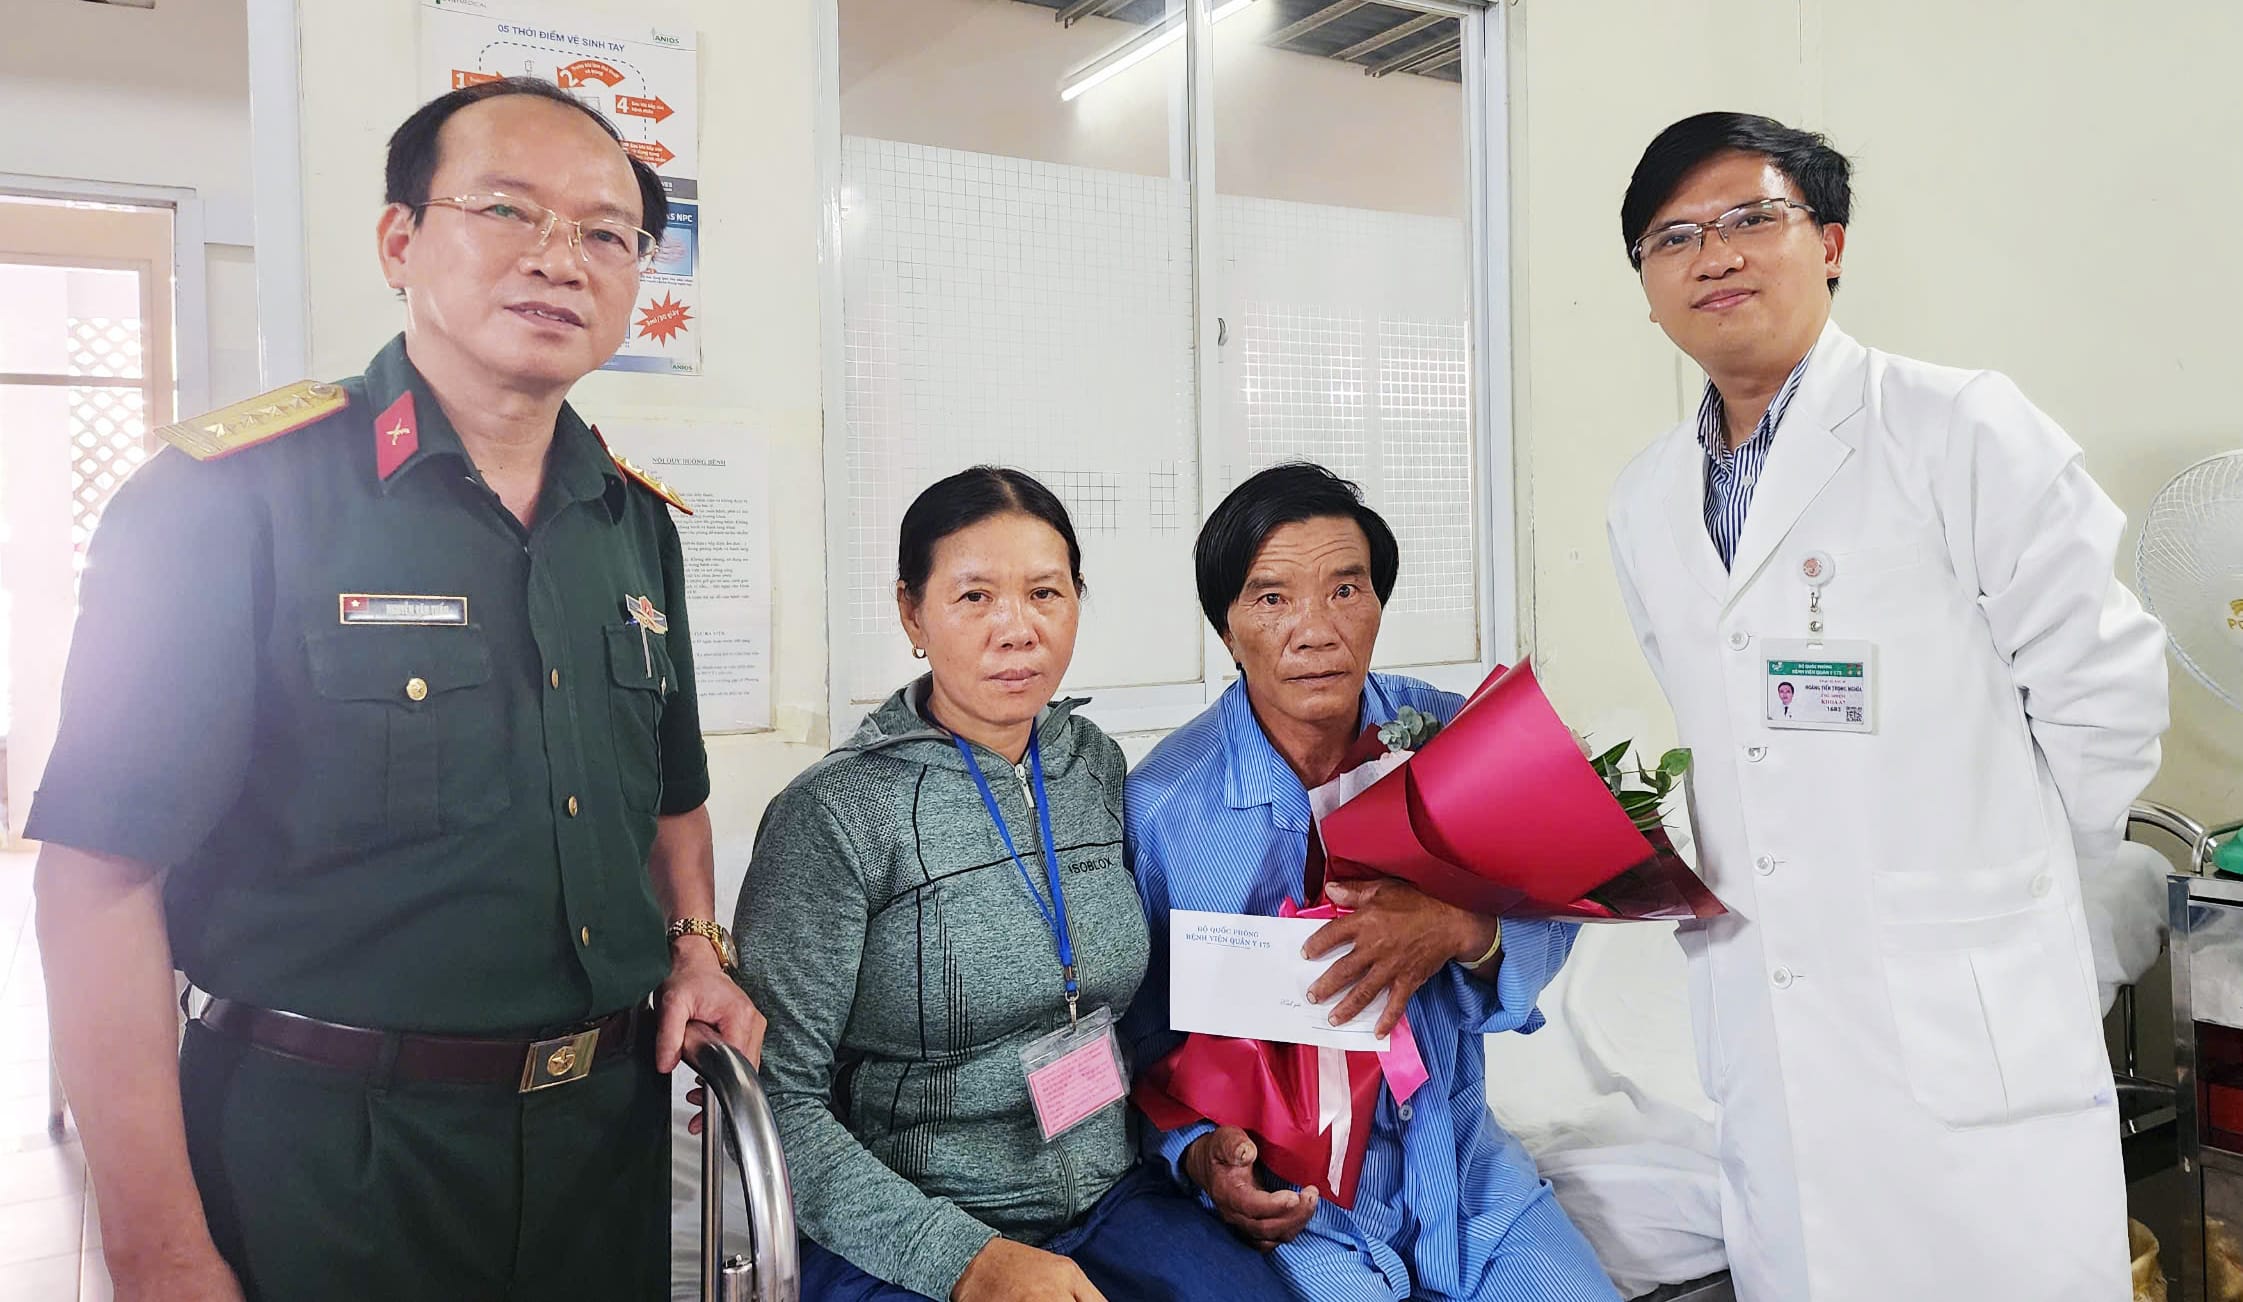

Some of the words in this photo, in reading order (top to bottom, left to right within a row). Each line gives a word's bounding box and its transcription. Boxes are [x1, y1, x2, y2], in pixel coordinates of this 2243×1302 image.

[497, 24, 509, 33] 05
[582, 38, 605, 49] SINH
[607, 43, 625, 52] TAY
[456, 72, 465, 88] 1
[560, 69, 581, 87] 2
[617, 97, 630, 113] 4
[676, 214, 693, 222] NPC
[1068, 857, 1114, 874] ISOBLOX
[1210, 926, 1232, 935] QUỐC
[1233, 928, 1259, 938] PHÒNG
[1230, 936, 1250, 946] QUÂN
[1259, 941, 1271, 949] 175
